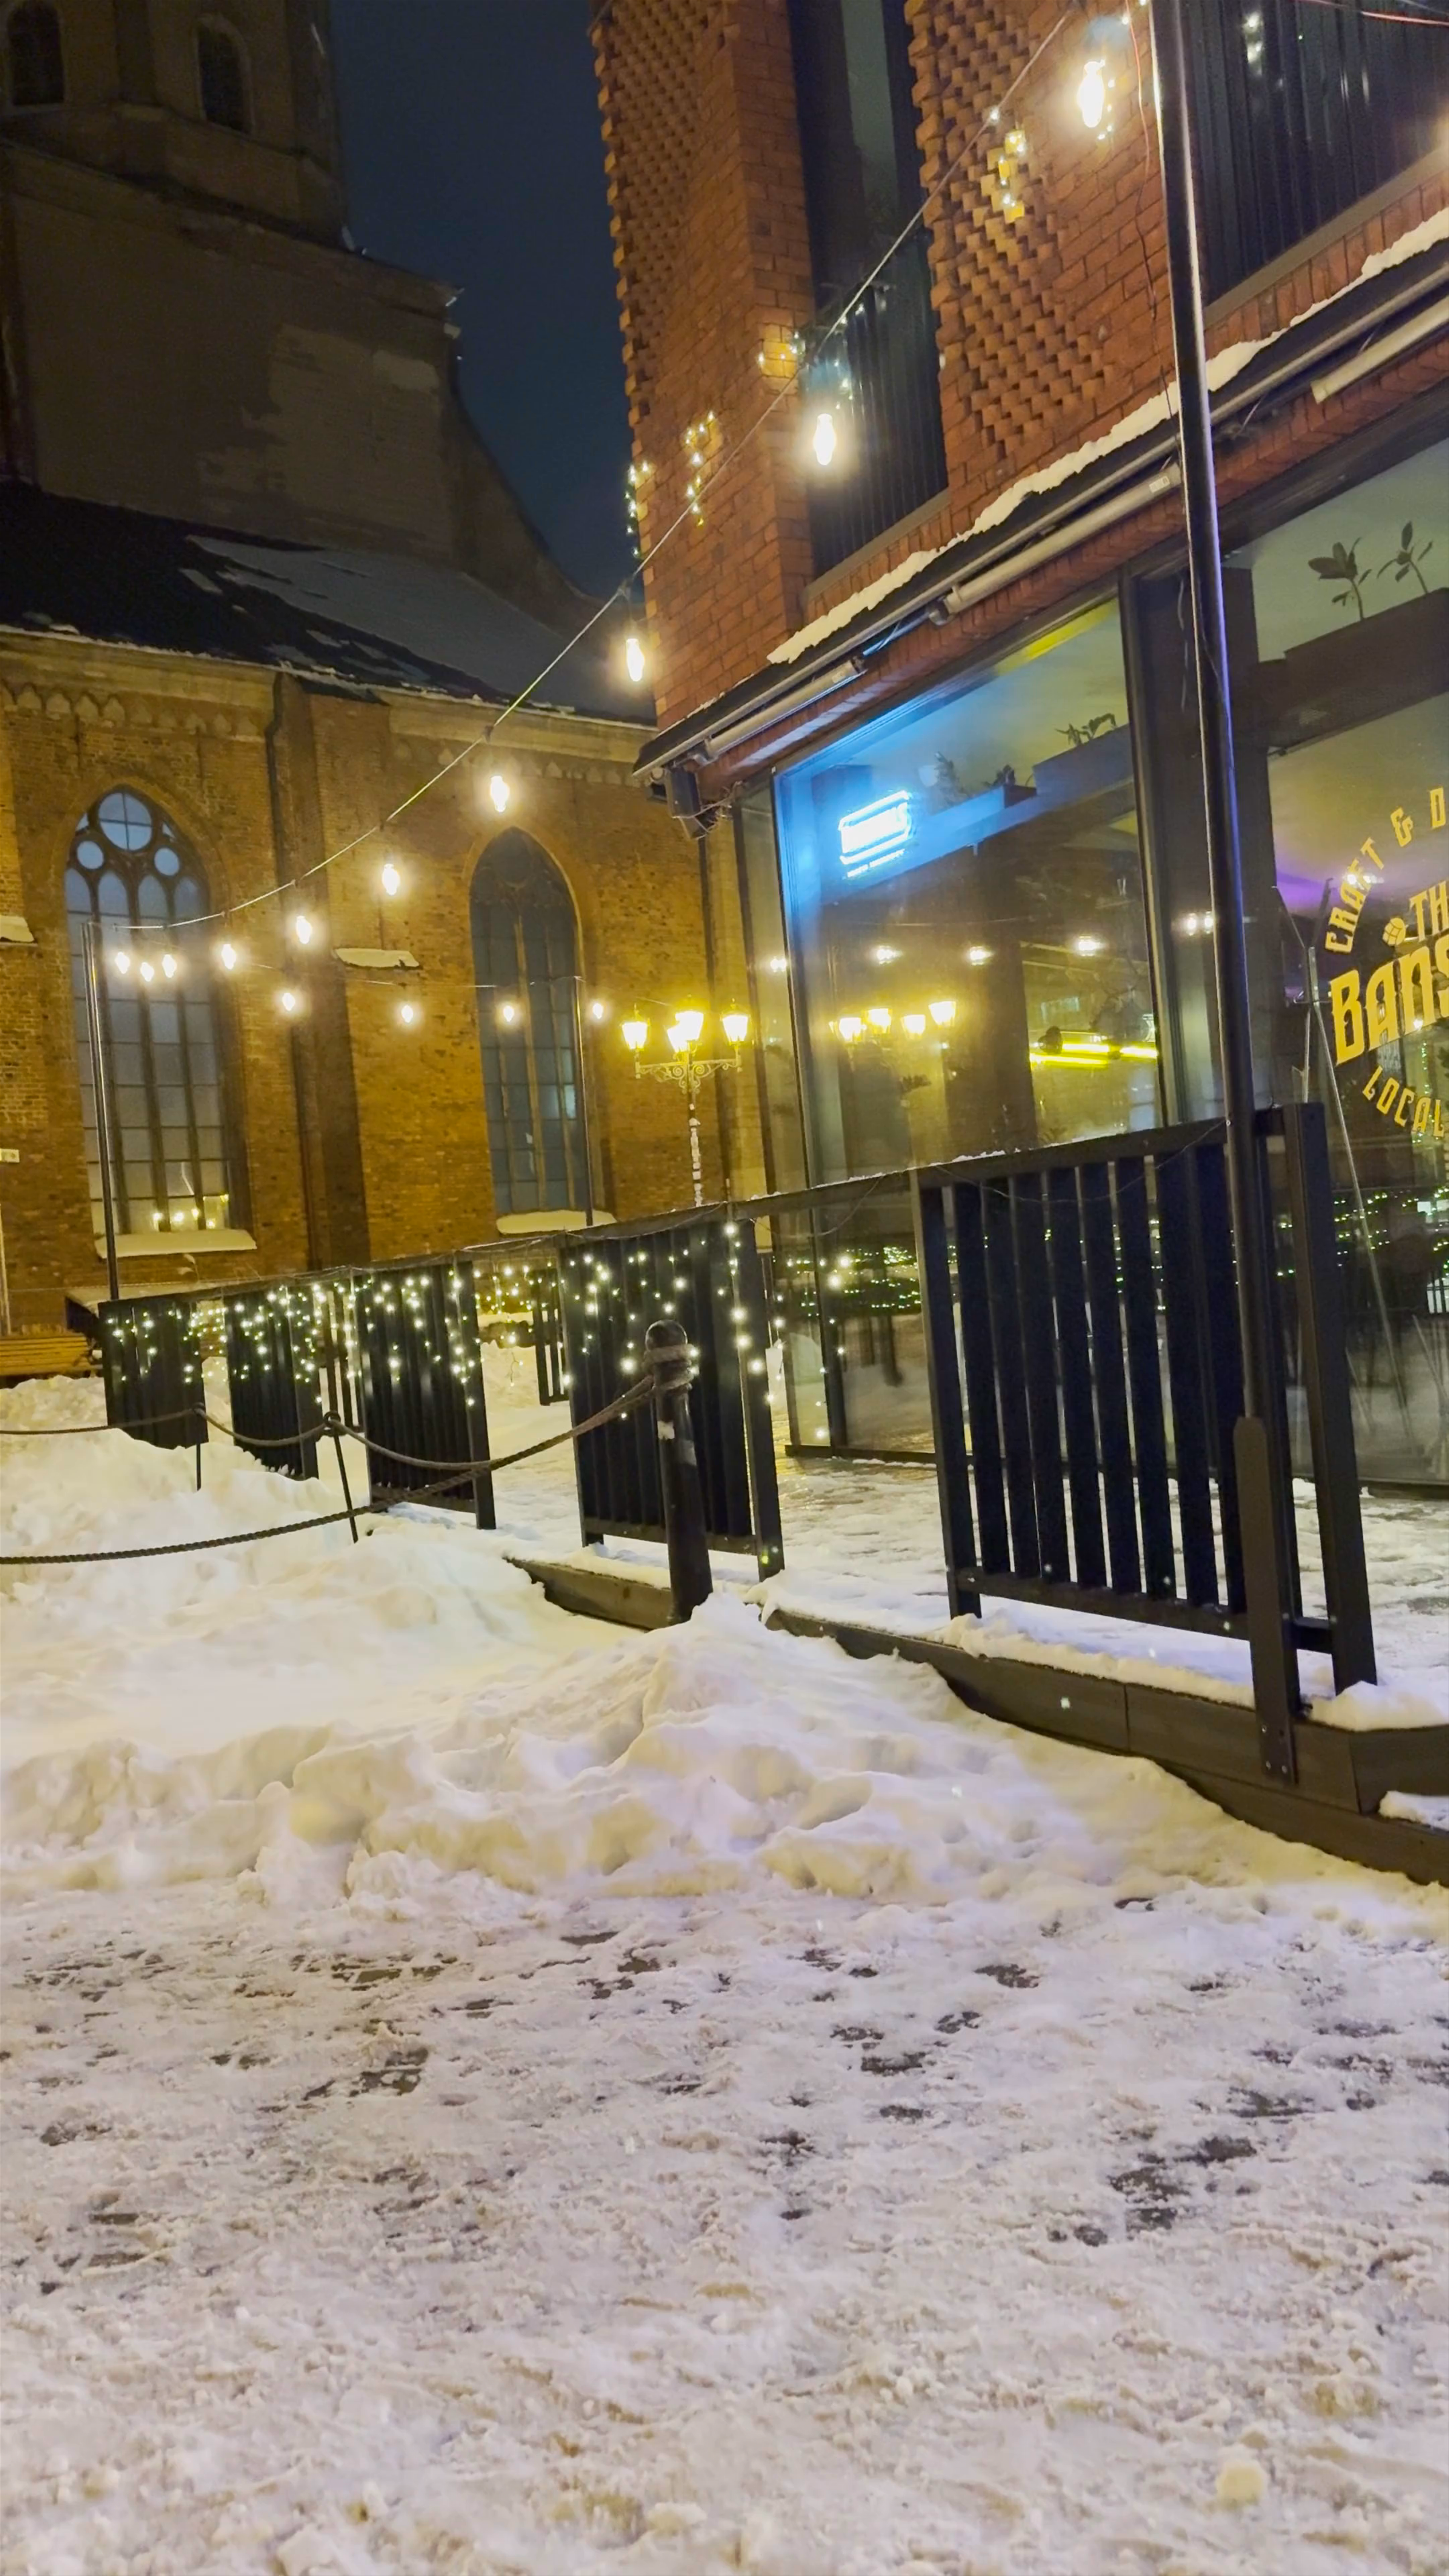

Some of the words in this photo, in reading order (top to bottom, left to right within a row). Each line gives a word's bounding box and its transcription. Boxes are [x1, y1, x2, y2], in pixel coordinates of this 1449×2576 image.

[1325, 837, 1384, 953] CRAFT
[1391, 807, 1414, 847] &
[1362, 1065, 1444, 1137] LOCAL
